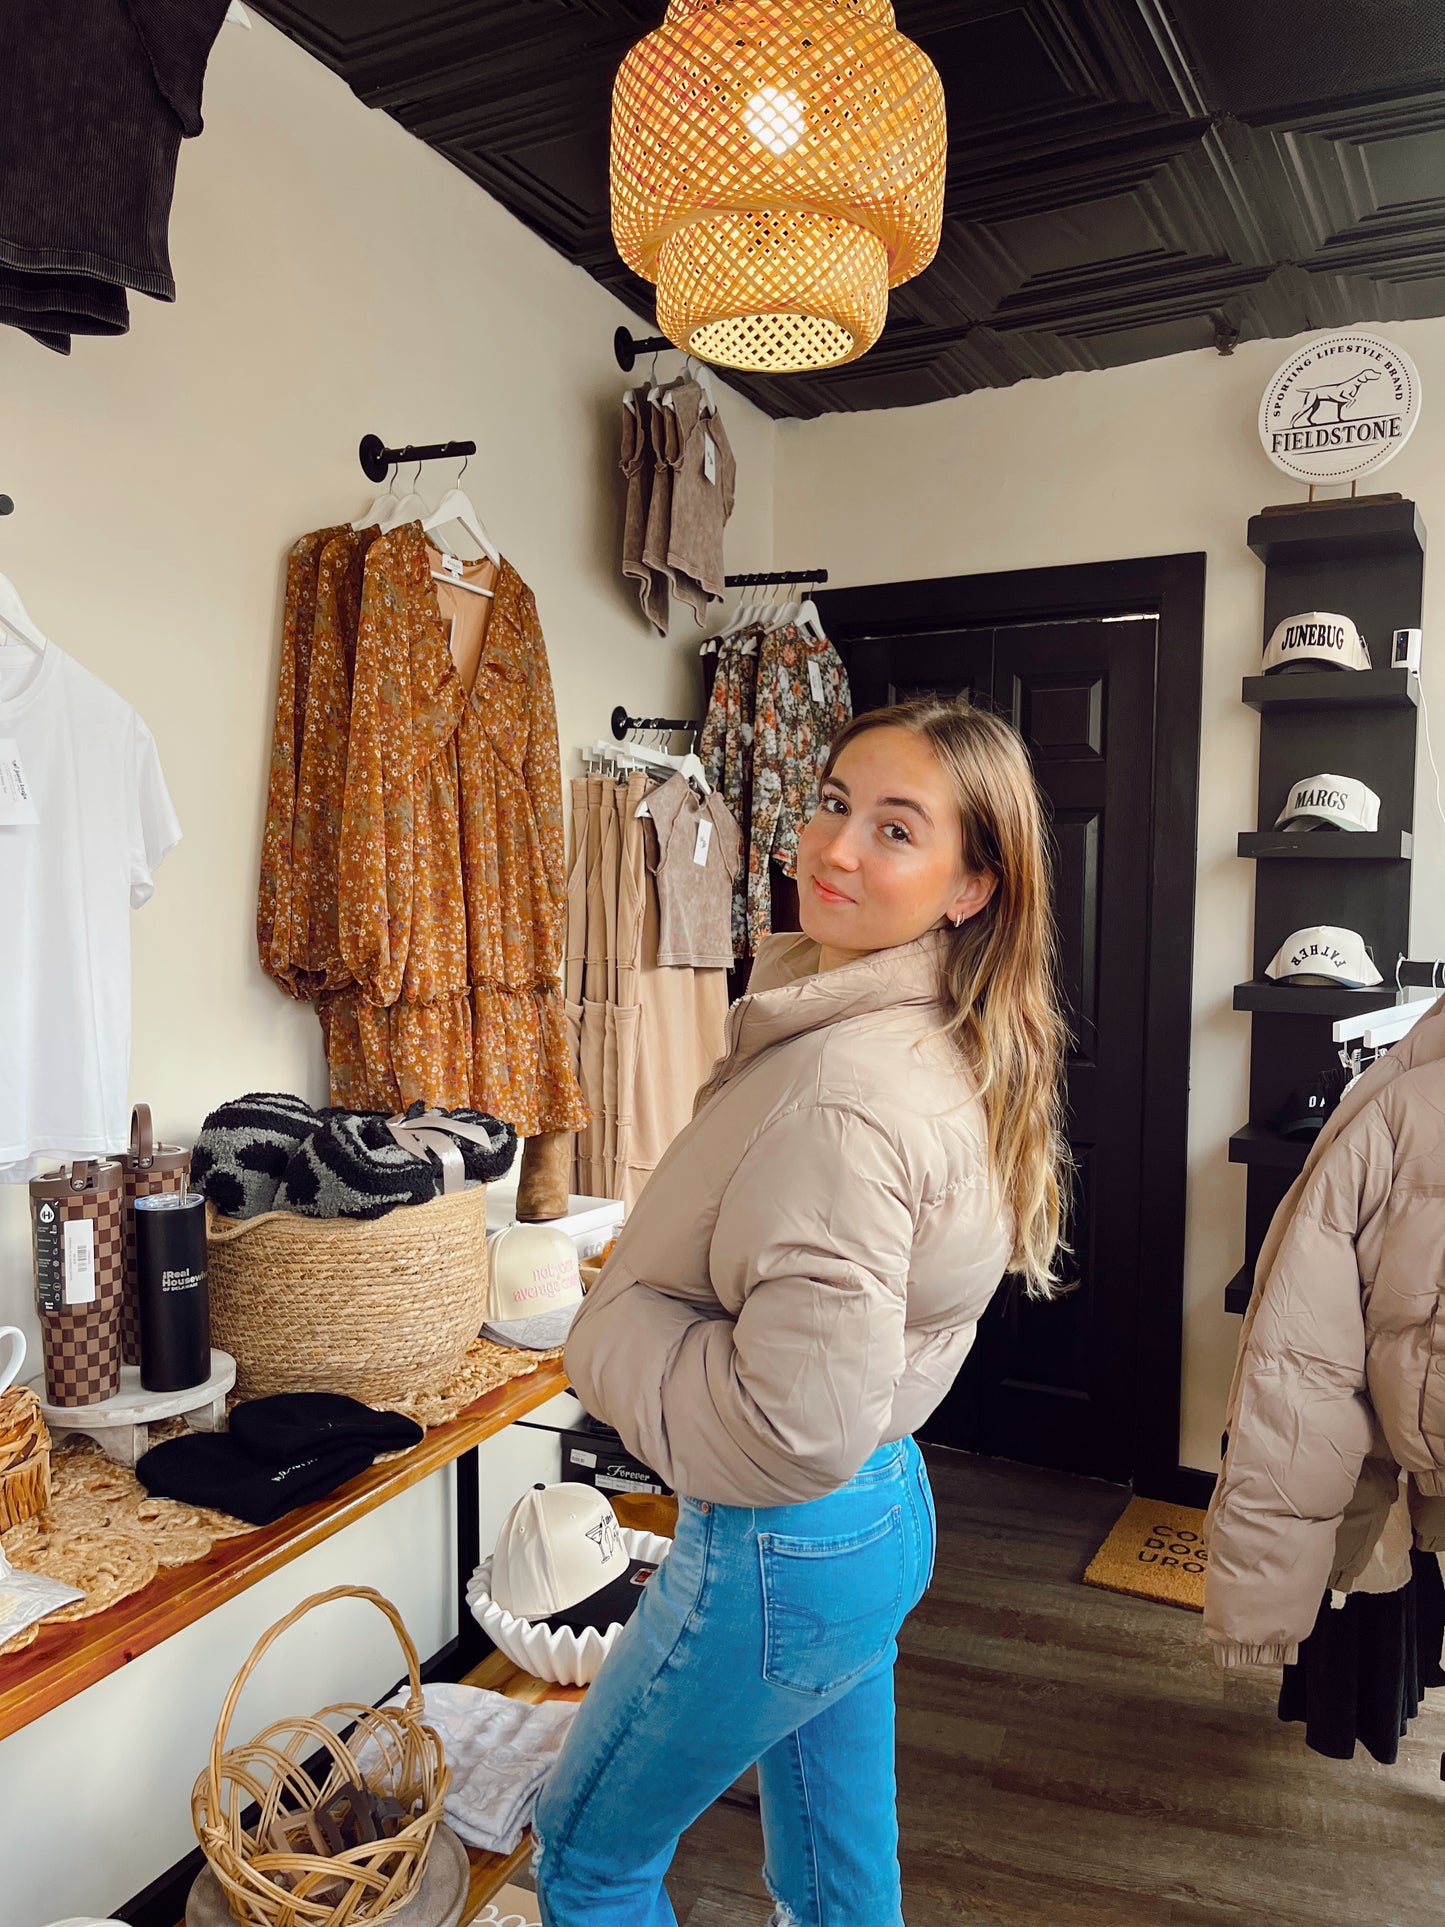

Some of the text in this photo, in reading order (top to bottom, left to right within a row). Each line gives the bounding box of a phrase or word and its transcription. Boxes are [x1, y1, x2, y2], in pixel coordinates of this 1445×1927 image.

[1273, 344, 1403, 418] SPORTING LIFESTYLE BRAND
[1271, 416, 1402, 453] FIELDSTONE
[1281, 624, 1344, 651] JUNEBUG
[1294, 789, 1348, 811] MARGS
[1291, 944, 1347, 968] FATHER
[166, 1267, 190, 1280] Real
[532, 1263, 553, 1282] not
[512, 1281, 561, 1302] average
[606, 1465, 650, 1482] Forever
[1152, 1525, 1204, 1545] CO
